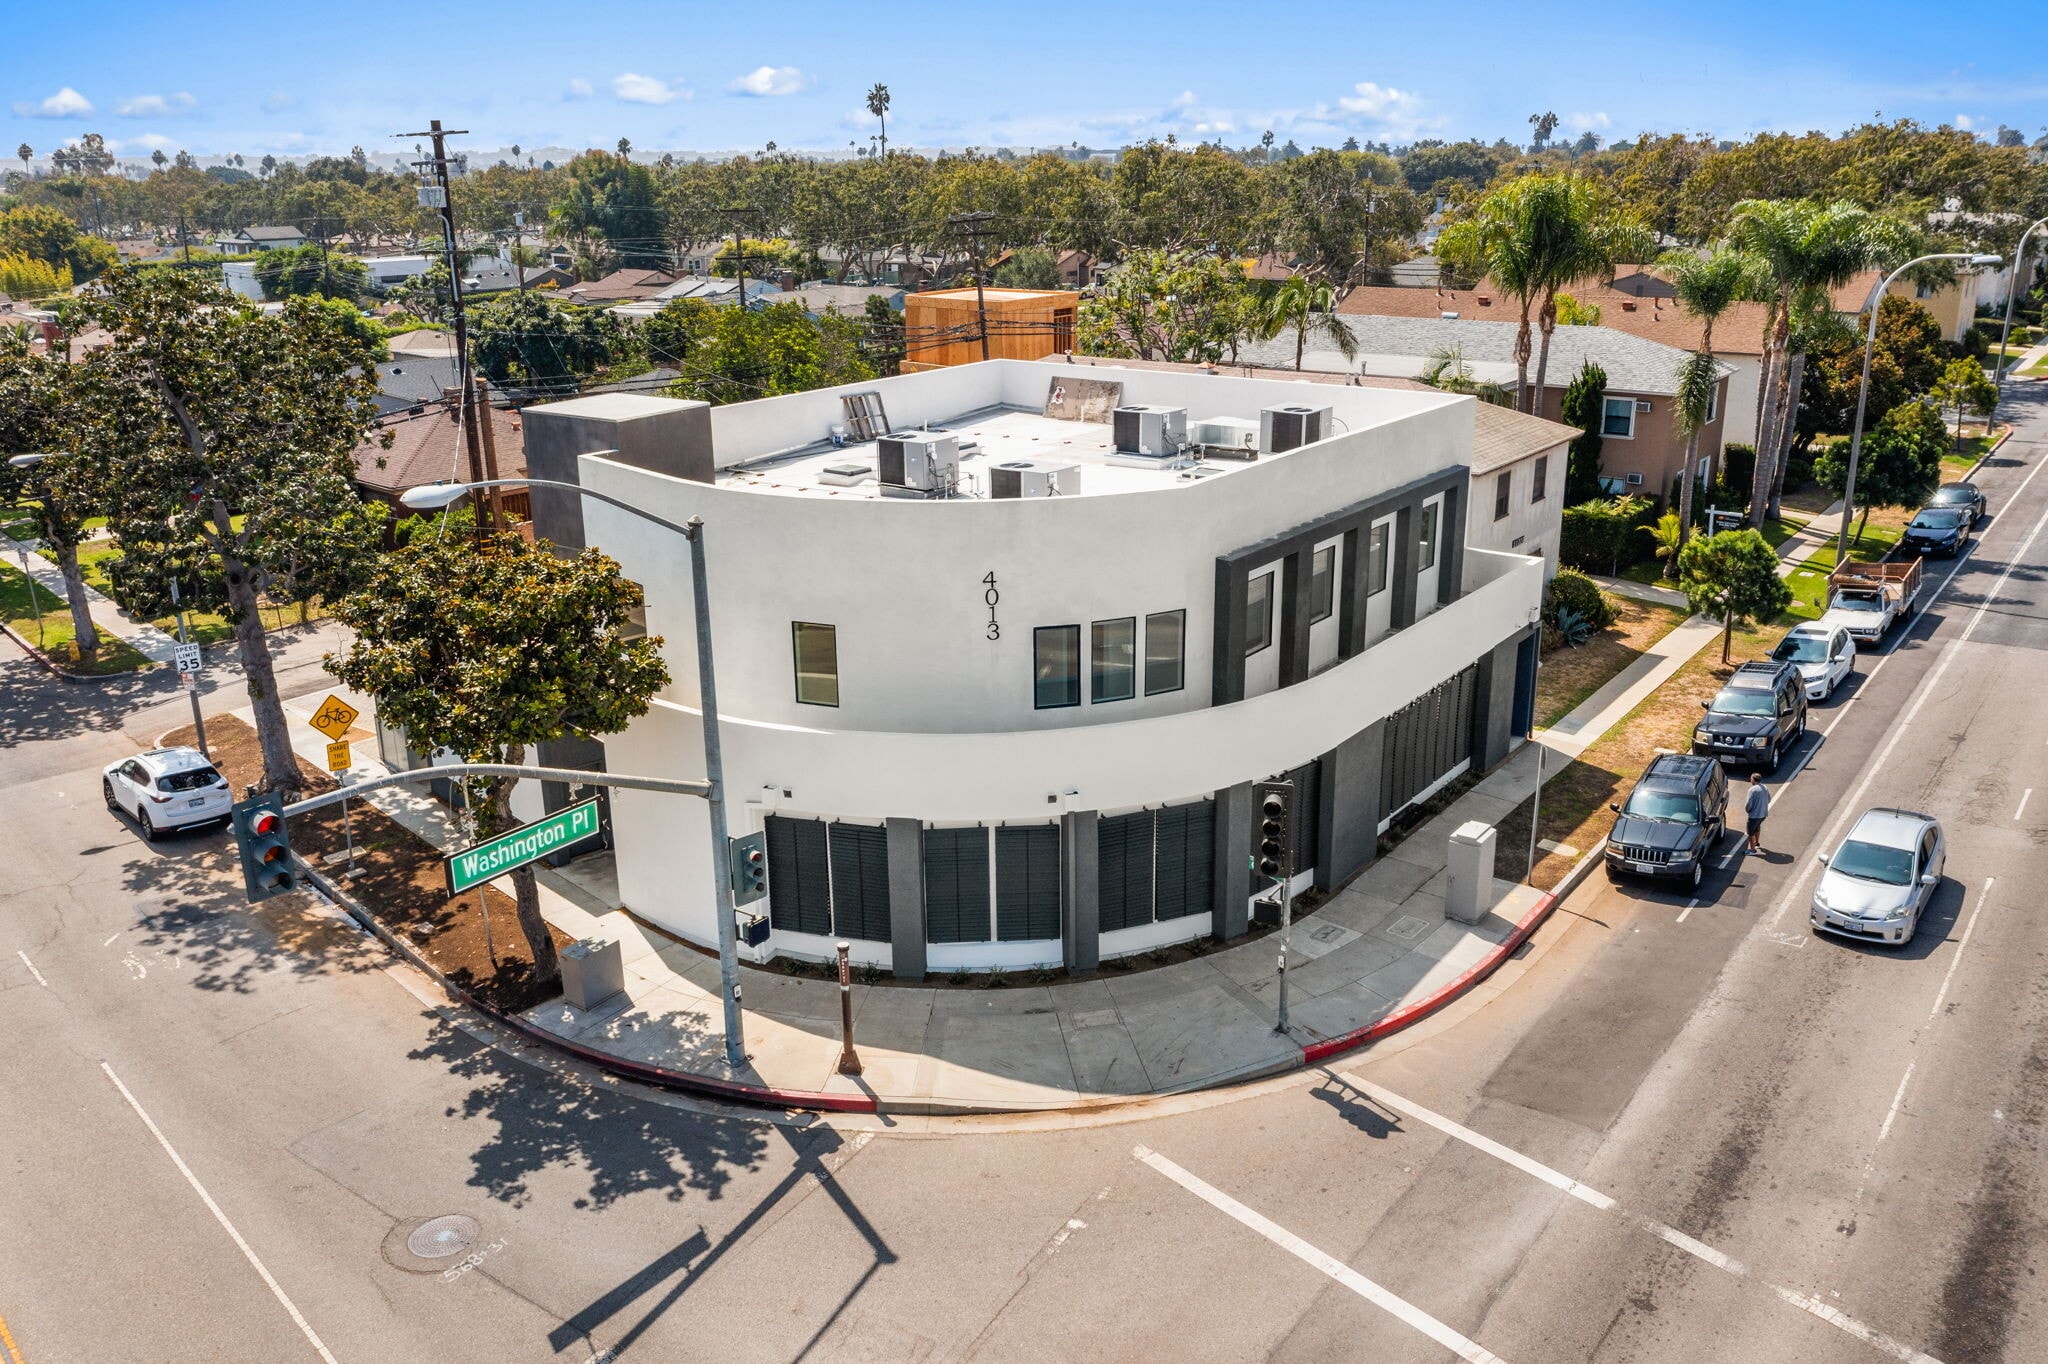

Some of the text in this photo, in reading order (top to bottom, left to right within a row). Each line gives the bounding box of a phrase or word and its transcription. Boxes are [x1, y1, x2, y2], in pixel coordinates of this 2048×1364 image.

[982, 571, 1000, 641] 4013
[175, 645, 198, 654] SPEED
[178, 651, 197, 660] LIMIT
[179, 658, 200, 671] 35
[328, 743, 347, 753] SHARE
[333, 751, 345, 760] THE
[332, 759, 348, 769] ROAD
[462, 808, 589, 879] Washington Pl
